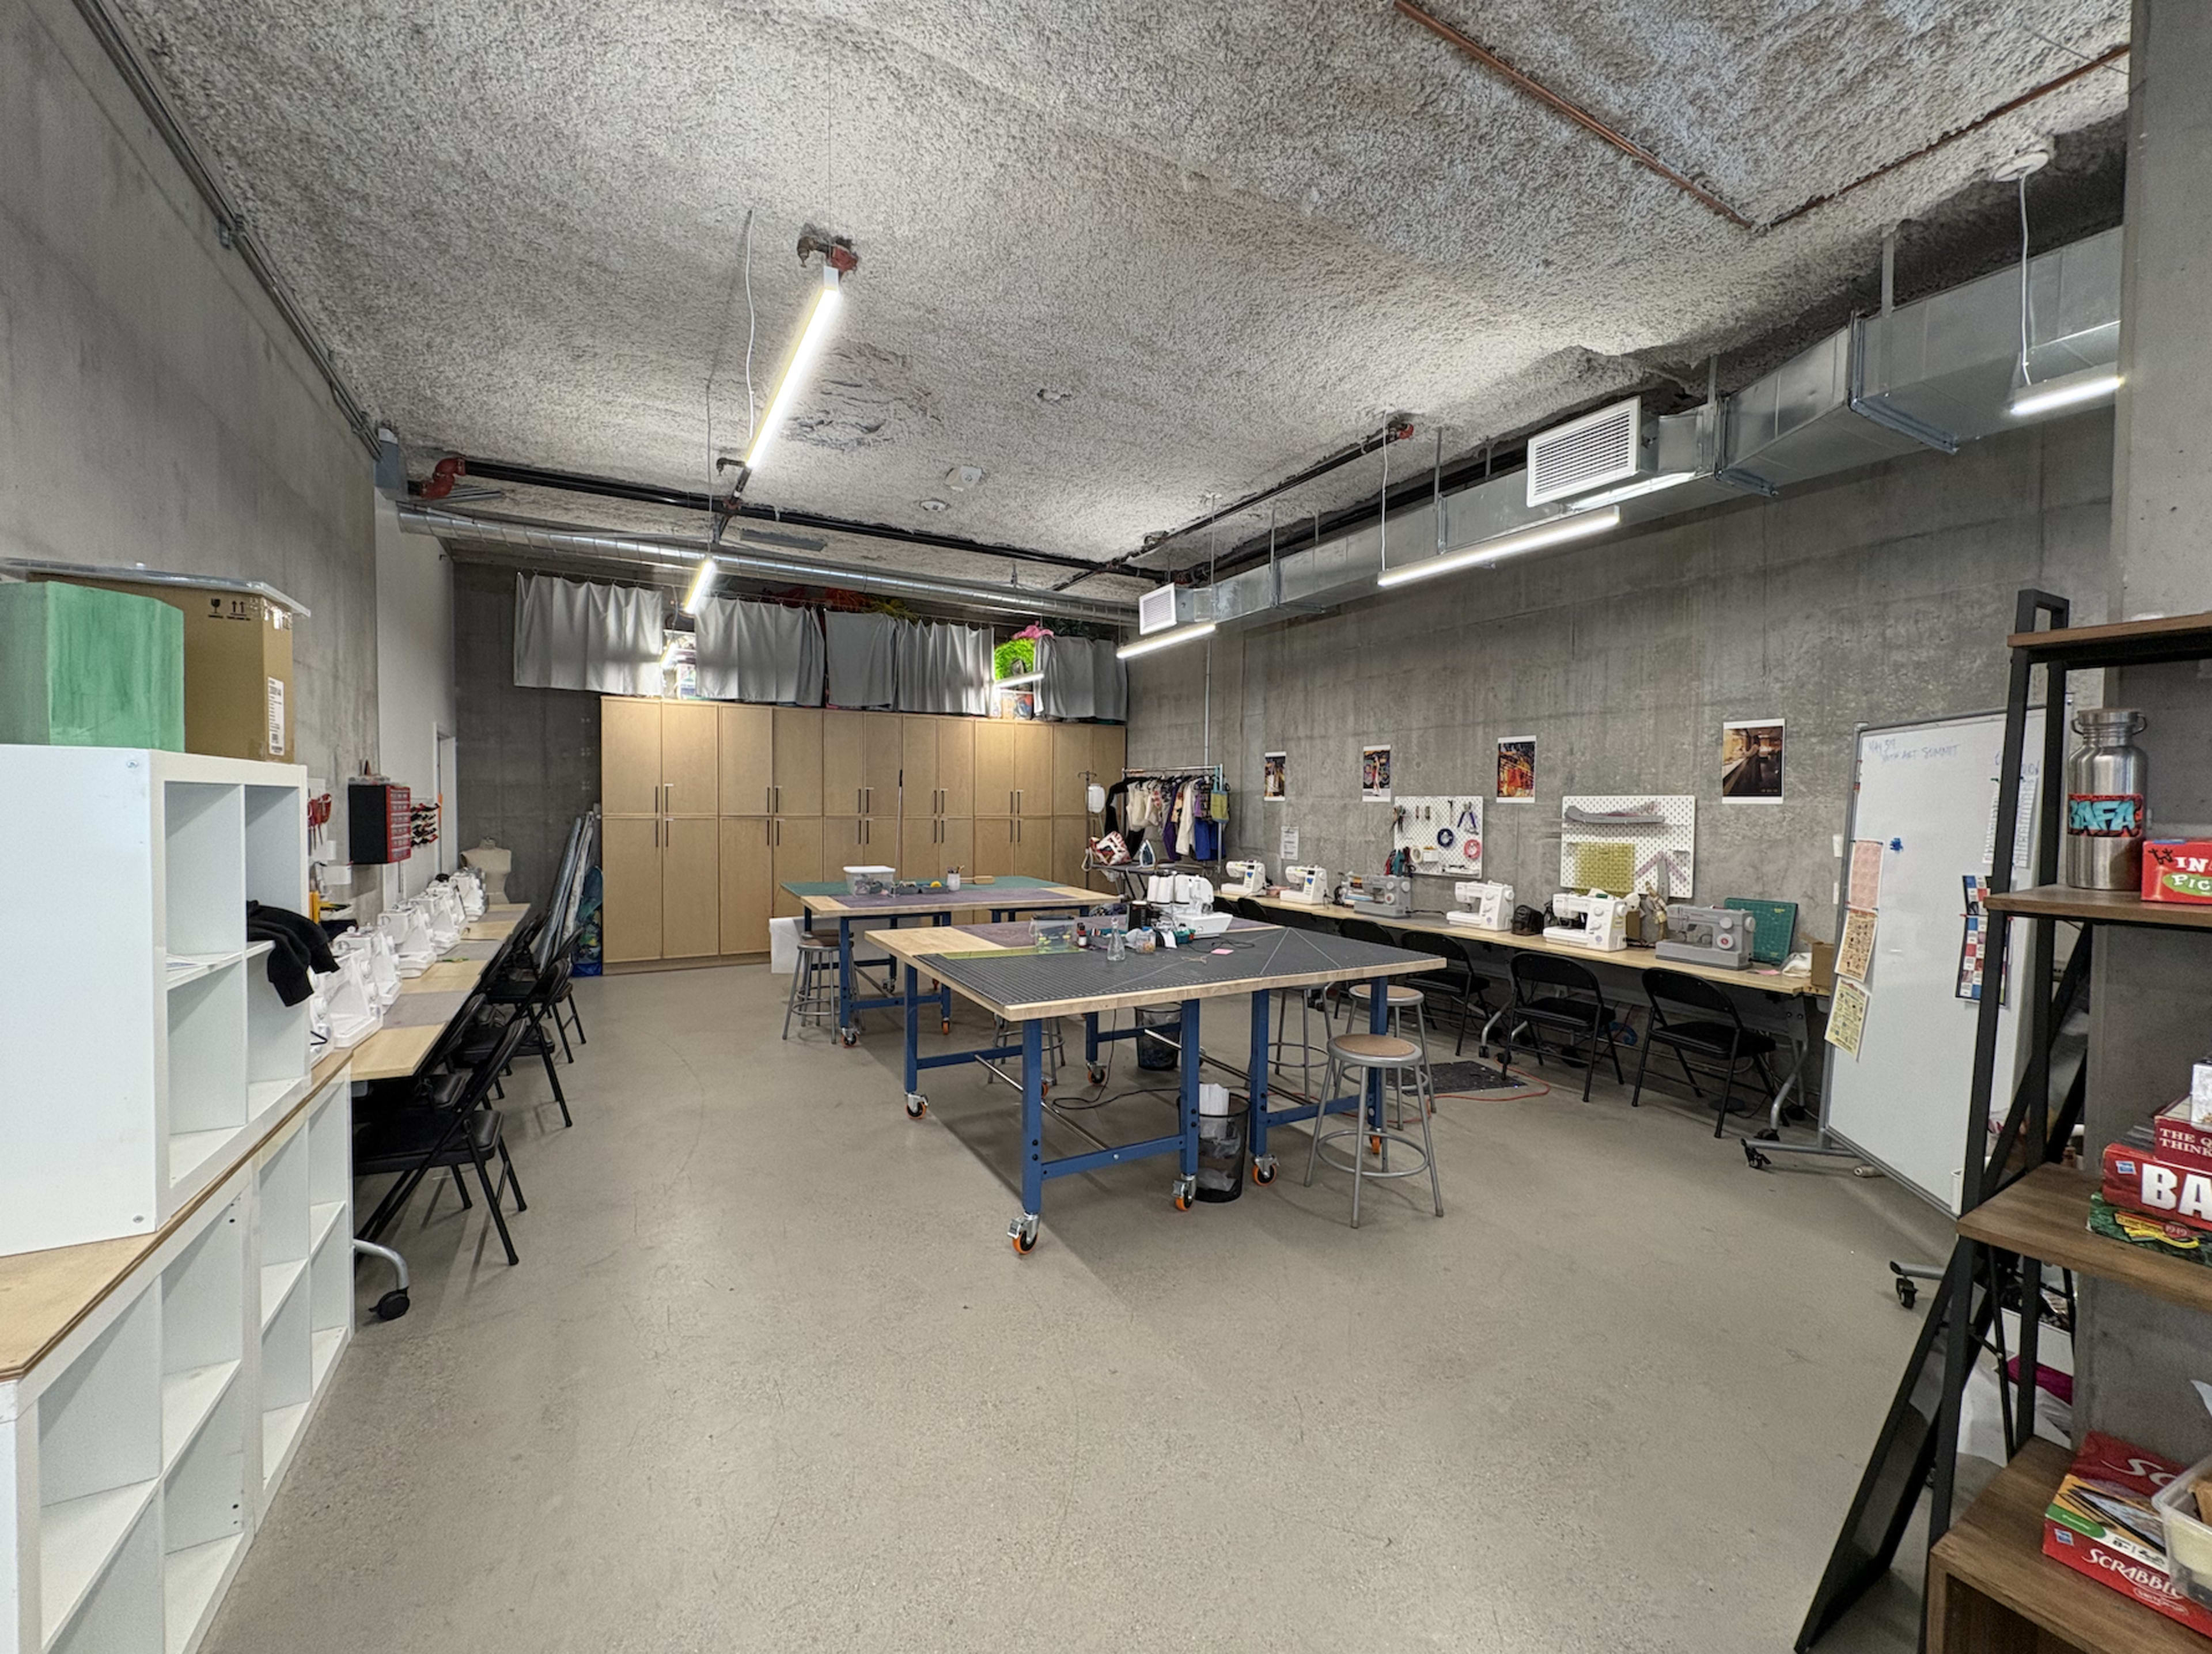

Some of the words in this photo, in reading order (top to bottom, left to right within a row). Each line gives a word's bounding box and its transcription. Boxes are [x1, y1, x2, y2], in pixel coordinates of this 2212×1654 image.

[2159, 1128, 2195, 1143] THE
[2158, 1138, 2212, 1158] THINK
[2141, 1162, 2212, 1222] BA
[2165, 1224, 2188, 1237] 1949
